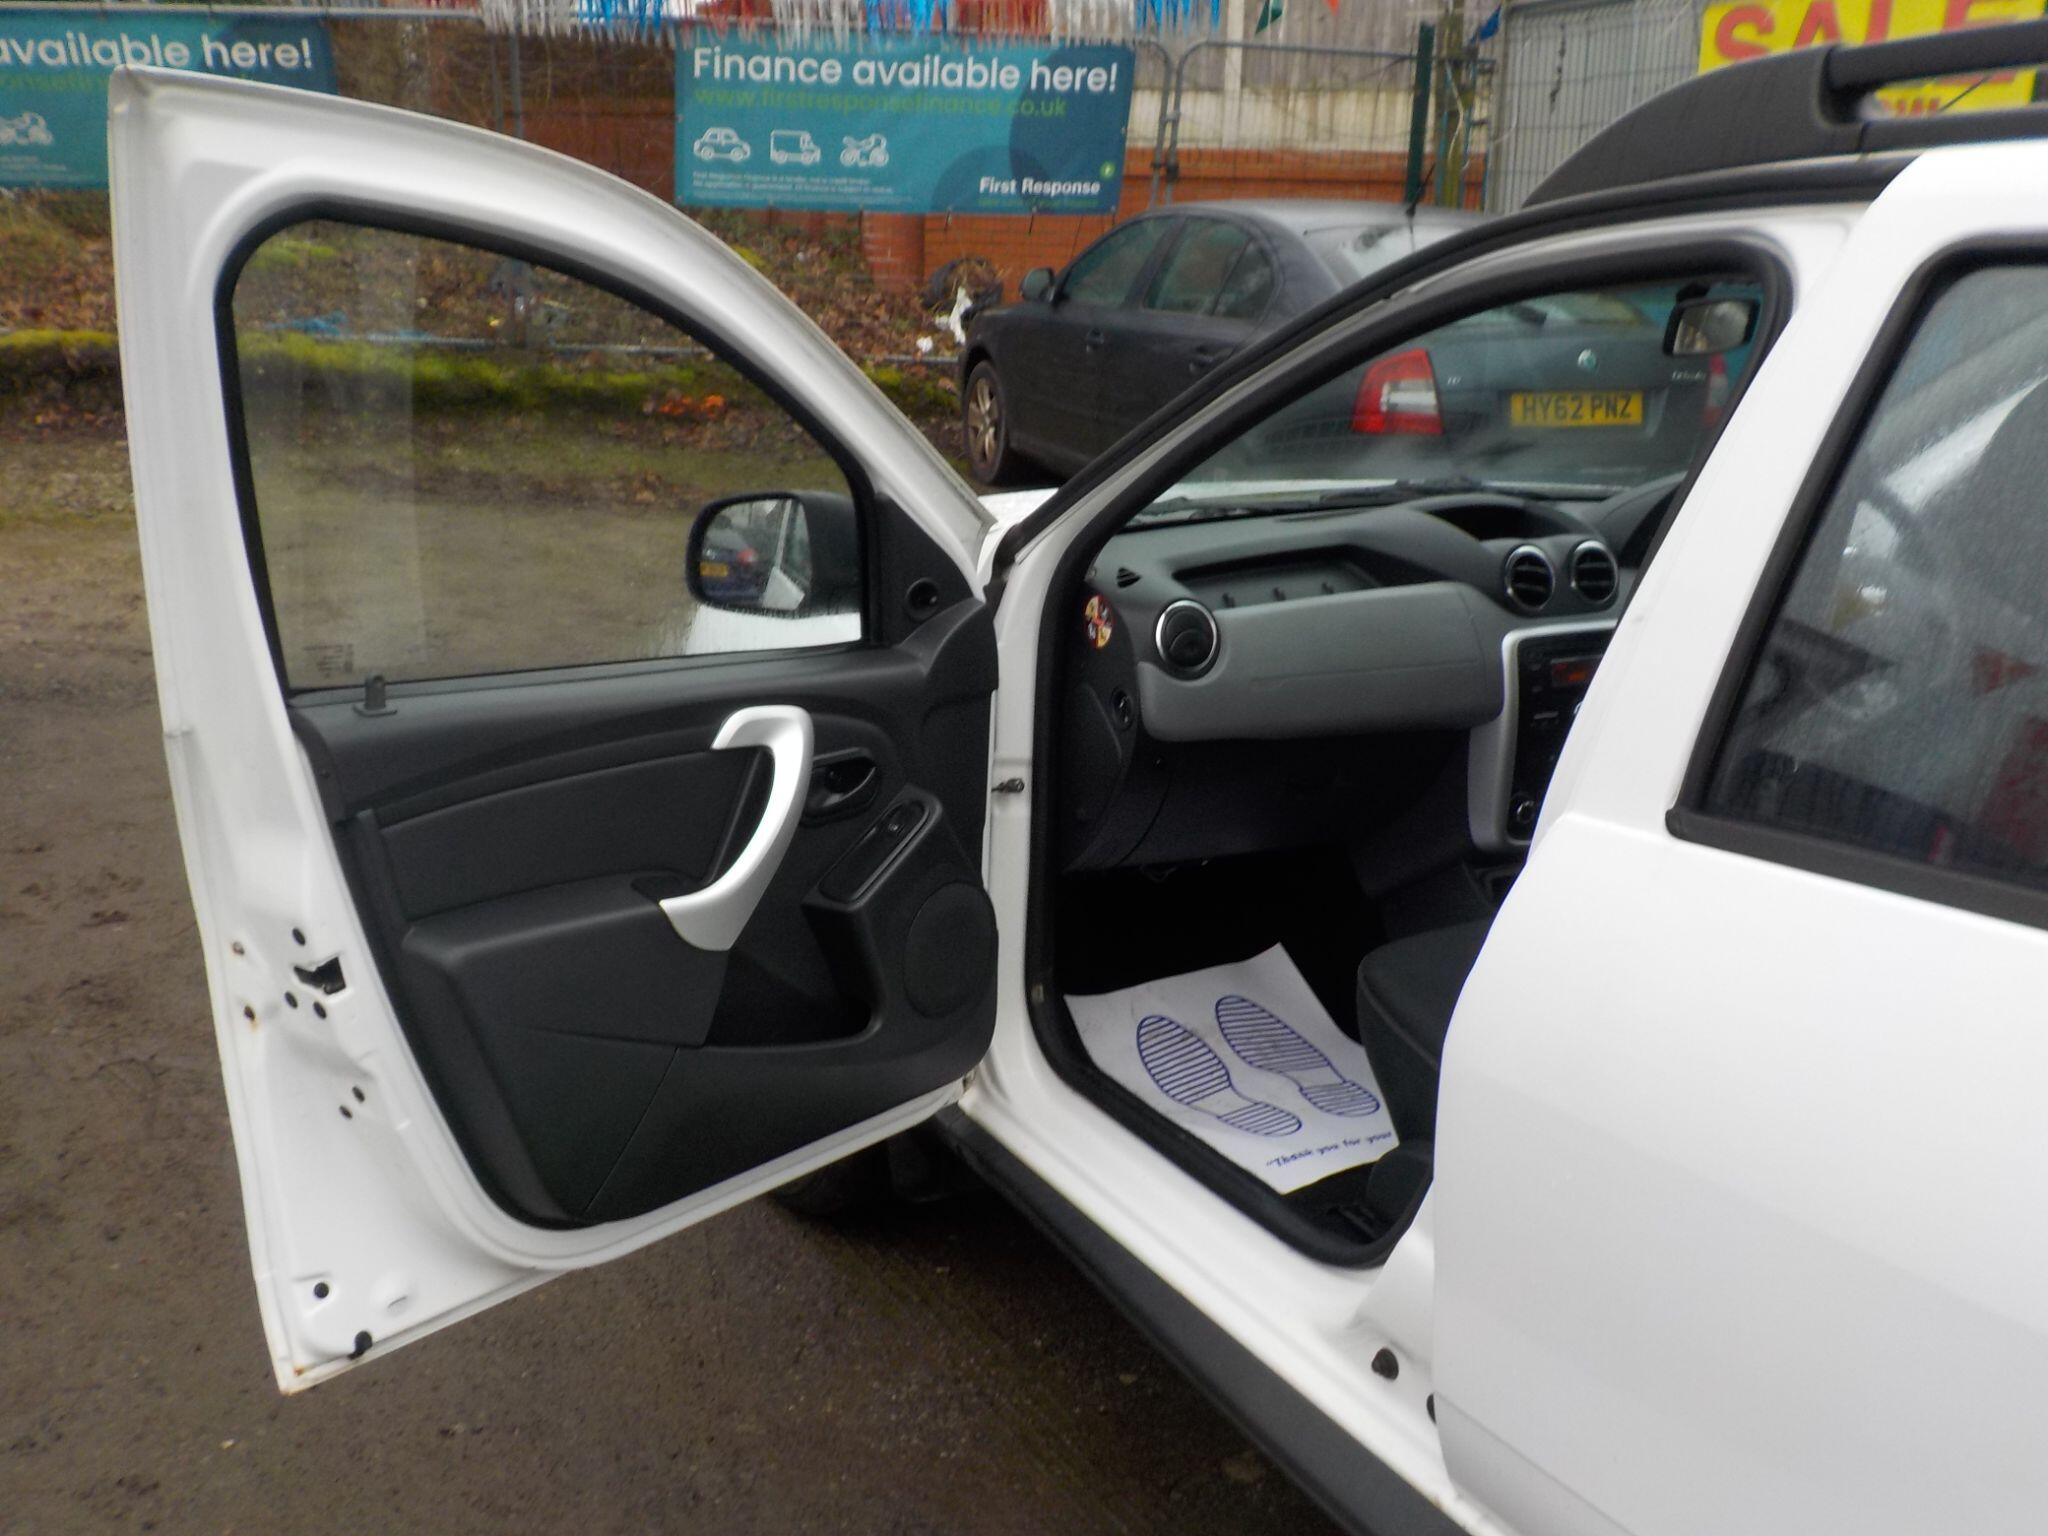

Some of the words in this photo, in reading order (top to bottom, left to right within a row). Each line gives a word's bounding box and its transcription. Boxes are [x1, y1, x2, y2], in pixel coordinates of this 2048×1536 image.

[200, 33, 312, 69] here!
[693, 45, 842, 85] Finance
[851, 52, 1021, 91] available
[1030, 57, 1118, 93] here!
[978, 175, 1017, 195] First
[1021, 176, 1101, 197] Response
[1522, 394, 1584, 423] HY62
[1590, 394, 1633, 420] PNZ
